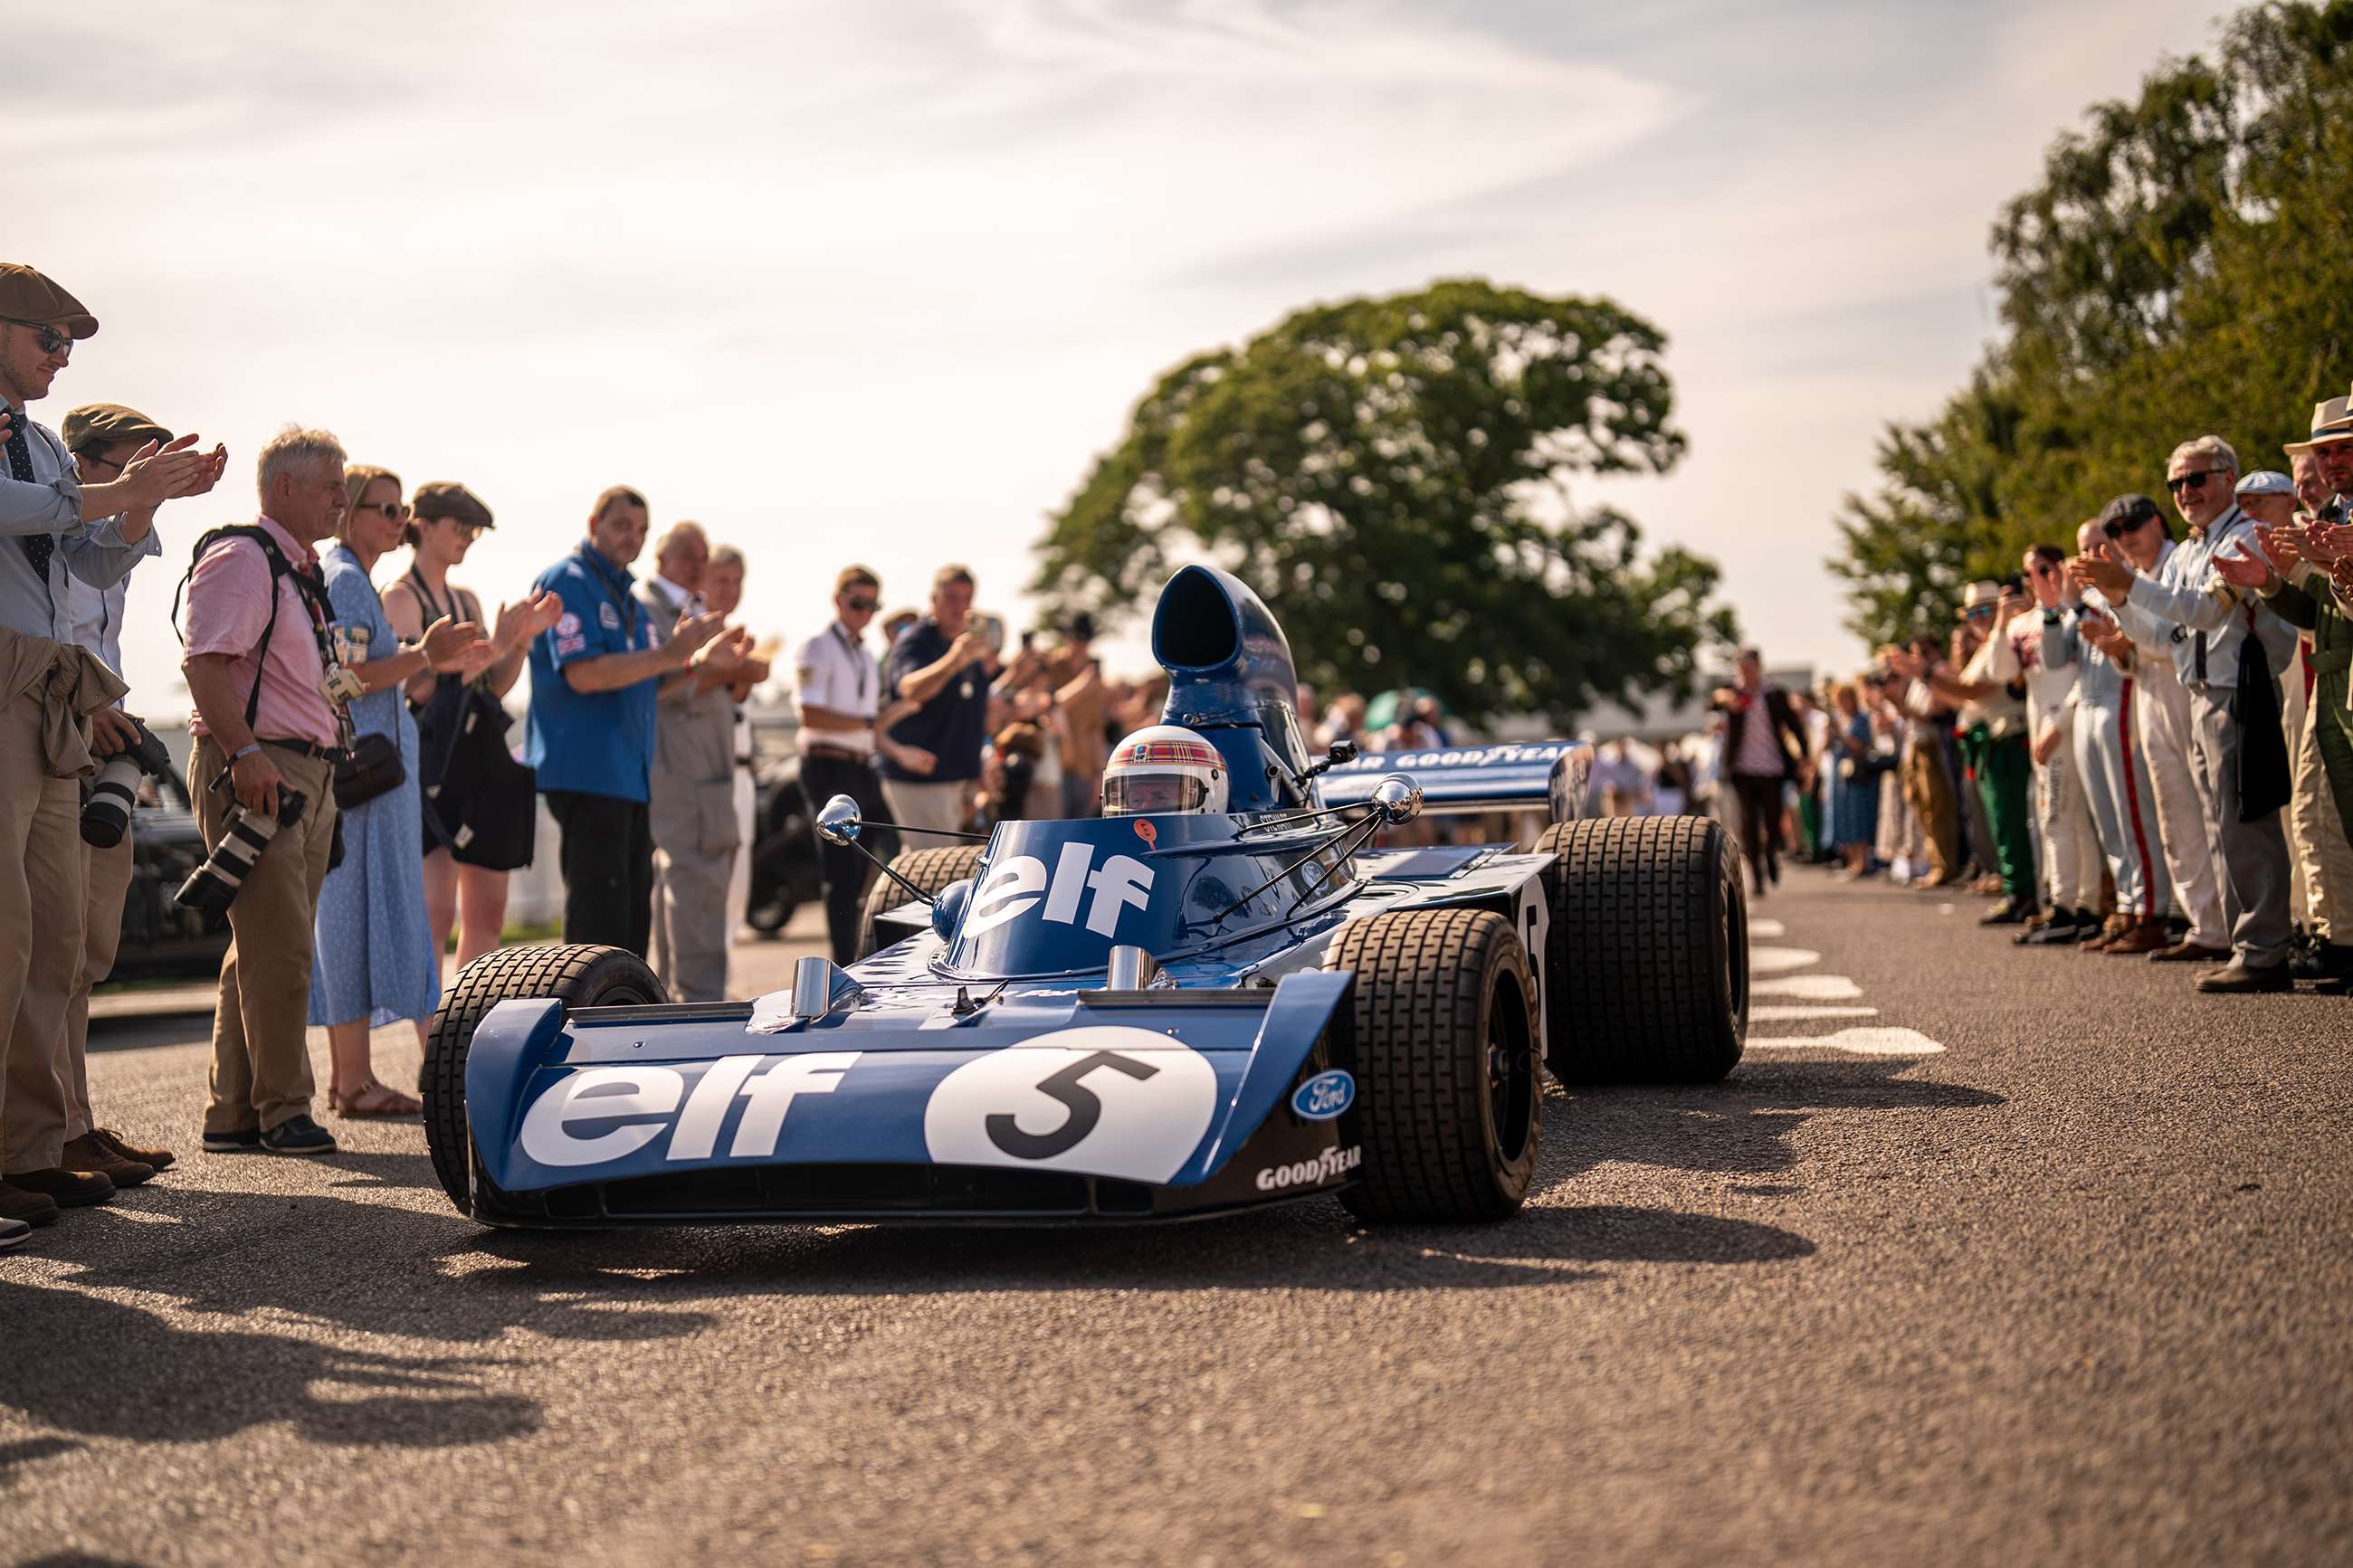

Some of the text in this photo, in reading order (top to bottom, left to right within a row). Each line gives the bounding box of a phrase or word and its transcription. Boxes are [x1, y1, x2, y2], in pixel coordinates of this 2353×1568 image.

[962, 841, 1156, 939] elf
[520, 1051, 863, 1167] elf
[986, 1050, 1161, 1160] 5
[1309, 1077, 1347, 1113] Ford
[1255, 1145, 1362, 1191] GOODYEAR
